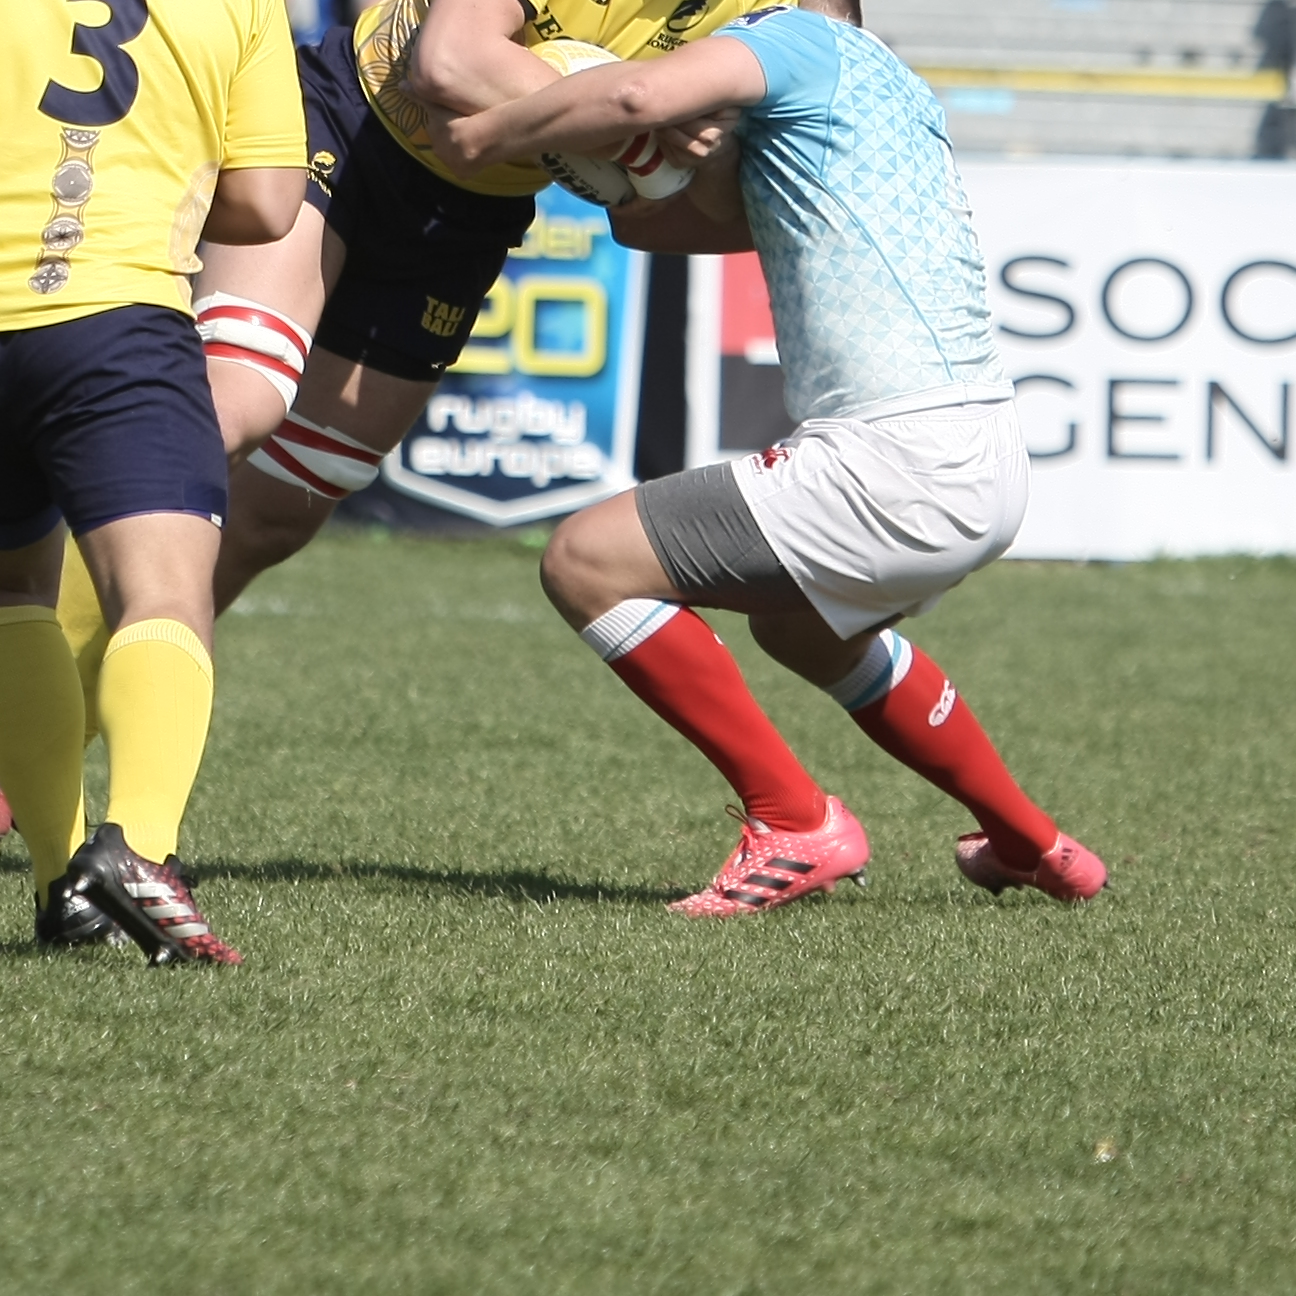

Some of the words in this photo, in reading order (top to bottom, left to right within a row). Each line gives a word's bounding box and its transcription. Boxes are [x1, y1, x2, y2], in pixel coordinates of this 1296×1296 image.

[421, 311, 459, 337] BALL
[426, 295, 466, 322] TALL
[427, 393, 587, 445] rugby
[409, 436, 603, 489] europe
